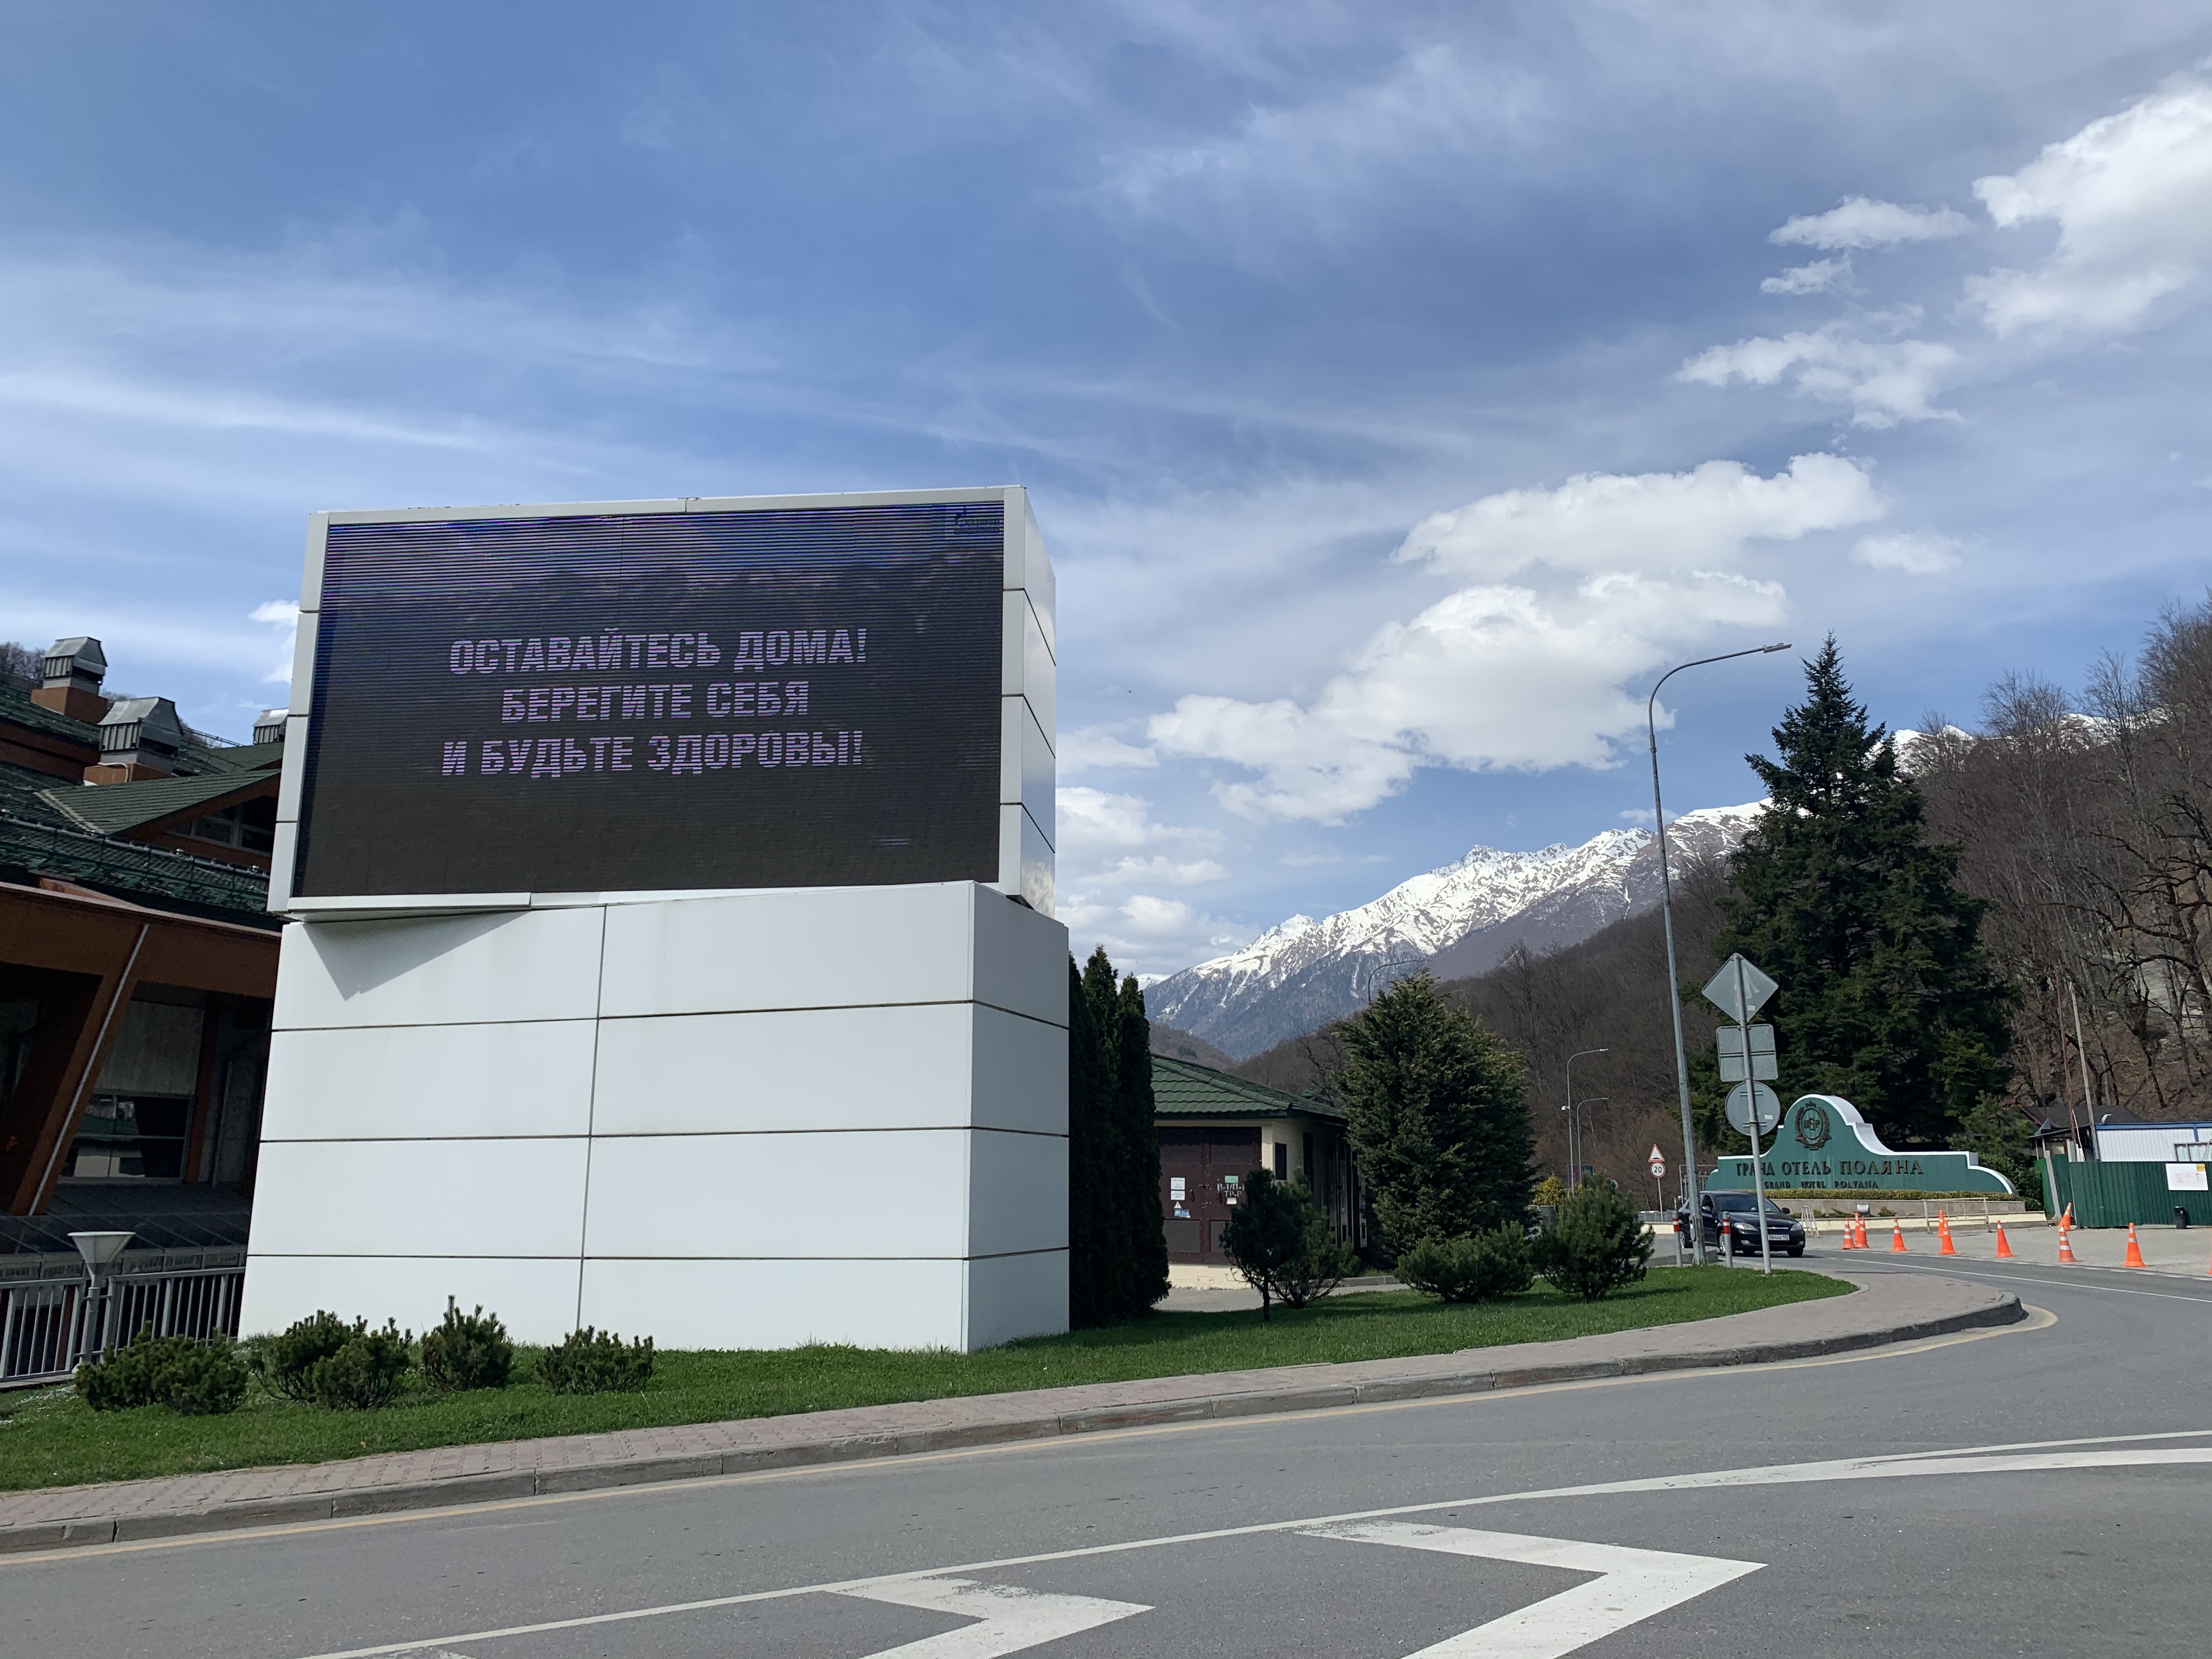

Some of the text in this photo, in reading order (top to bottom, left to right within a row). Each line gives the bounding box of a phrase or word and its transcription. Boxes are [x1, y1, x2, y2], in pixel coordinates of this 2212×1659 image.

[449, 628, 867, 674] ОСТАВАЙТЕСЬ ДОМА!
[501, 681, 809, 723] БЕРЕГИТЕ СЕБЯ
[442, 731, 862, 778] И БУДЬТЕ ЗДОРОВЫ!
[1736, 1160, 1924, 1176] ГРАНД ОТЕЛЬ ПОЛЯНА
[1764, 1181, 1791, 1189] GRAND
[1801, 1181, 1826, 1189] HOTEL
